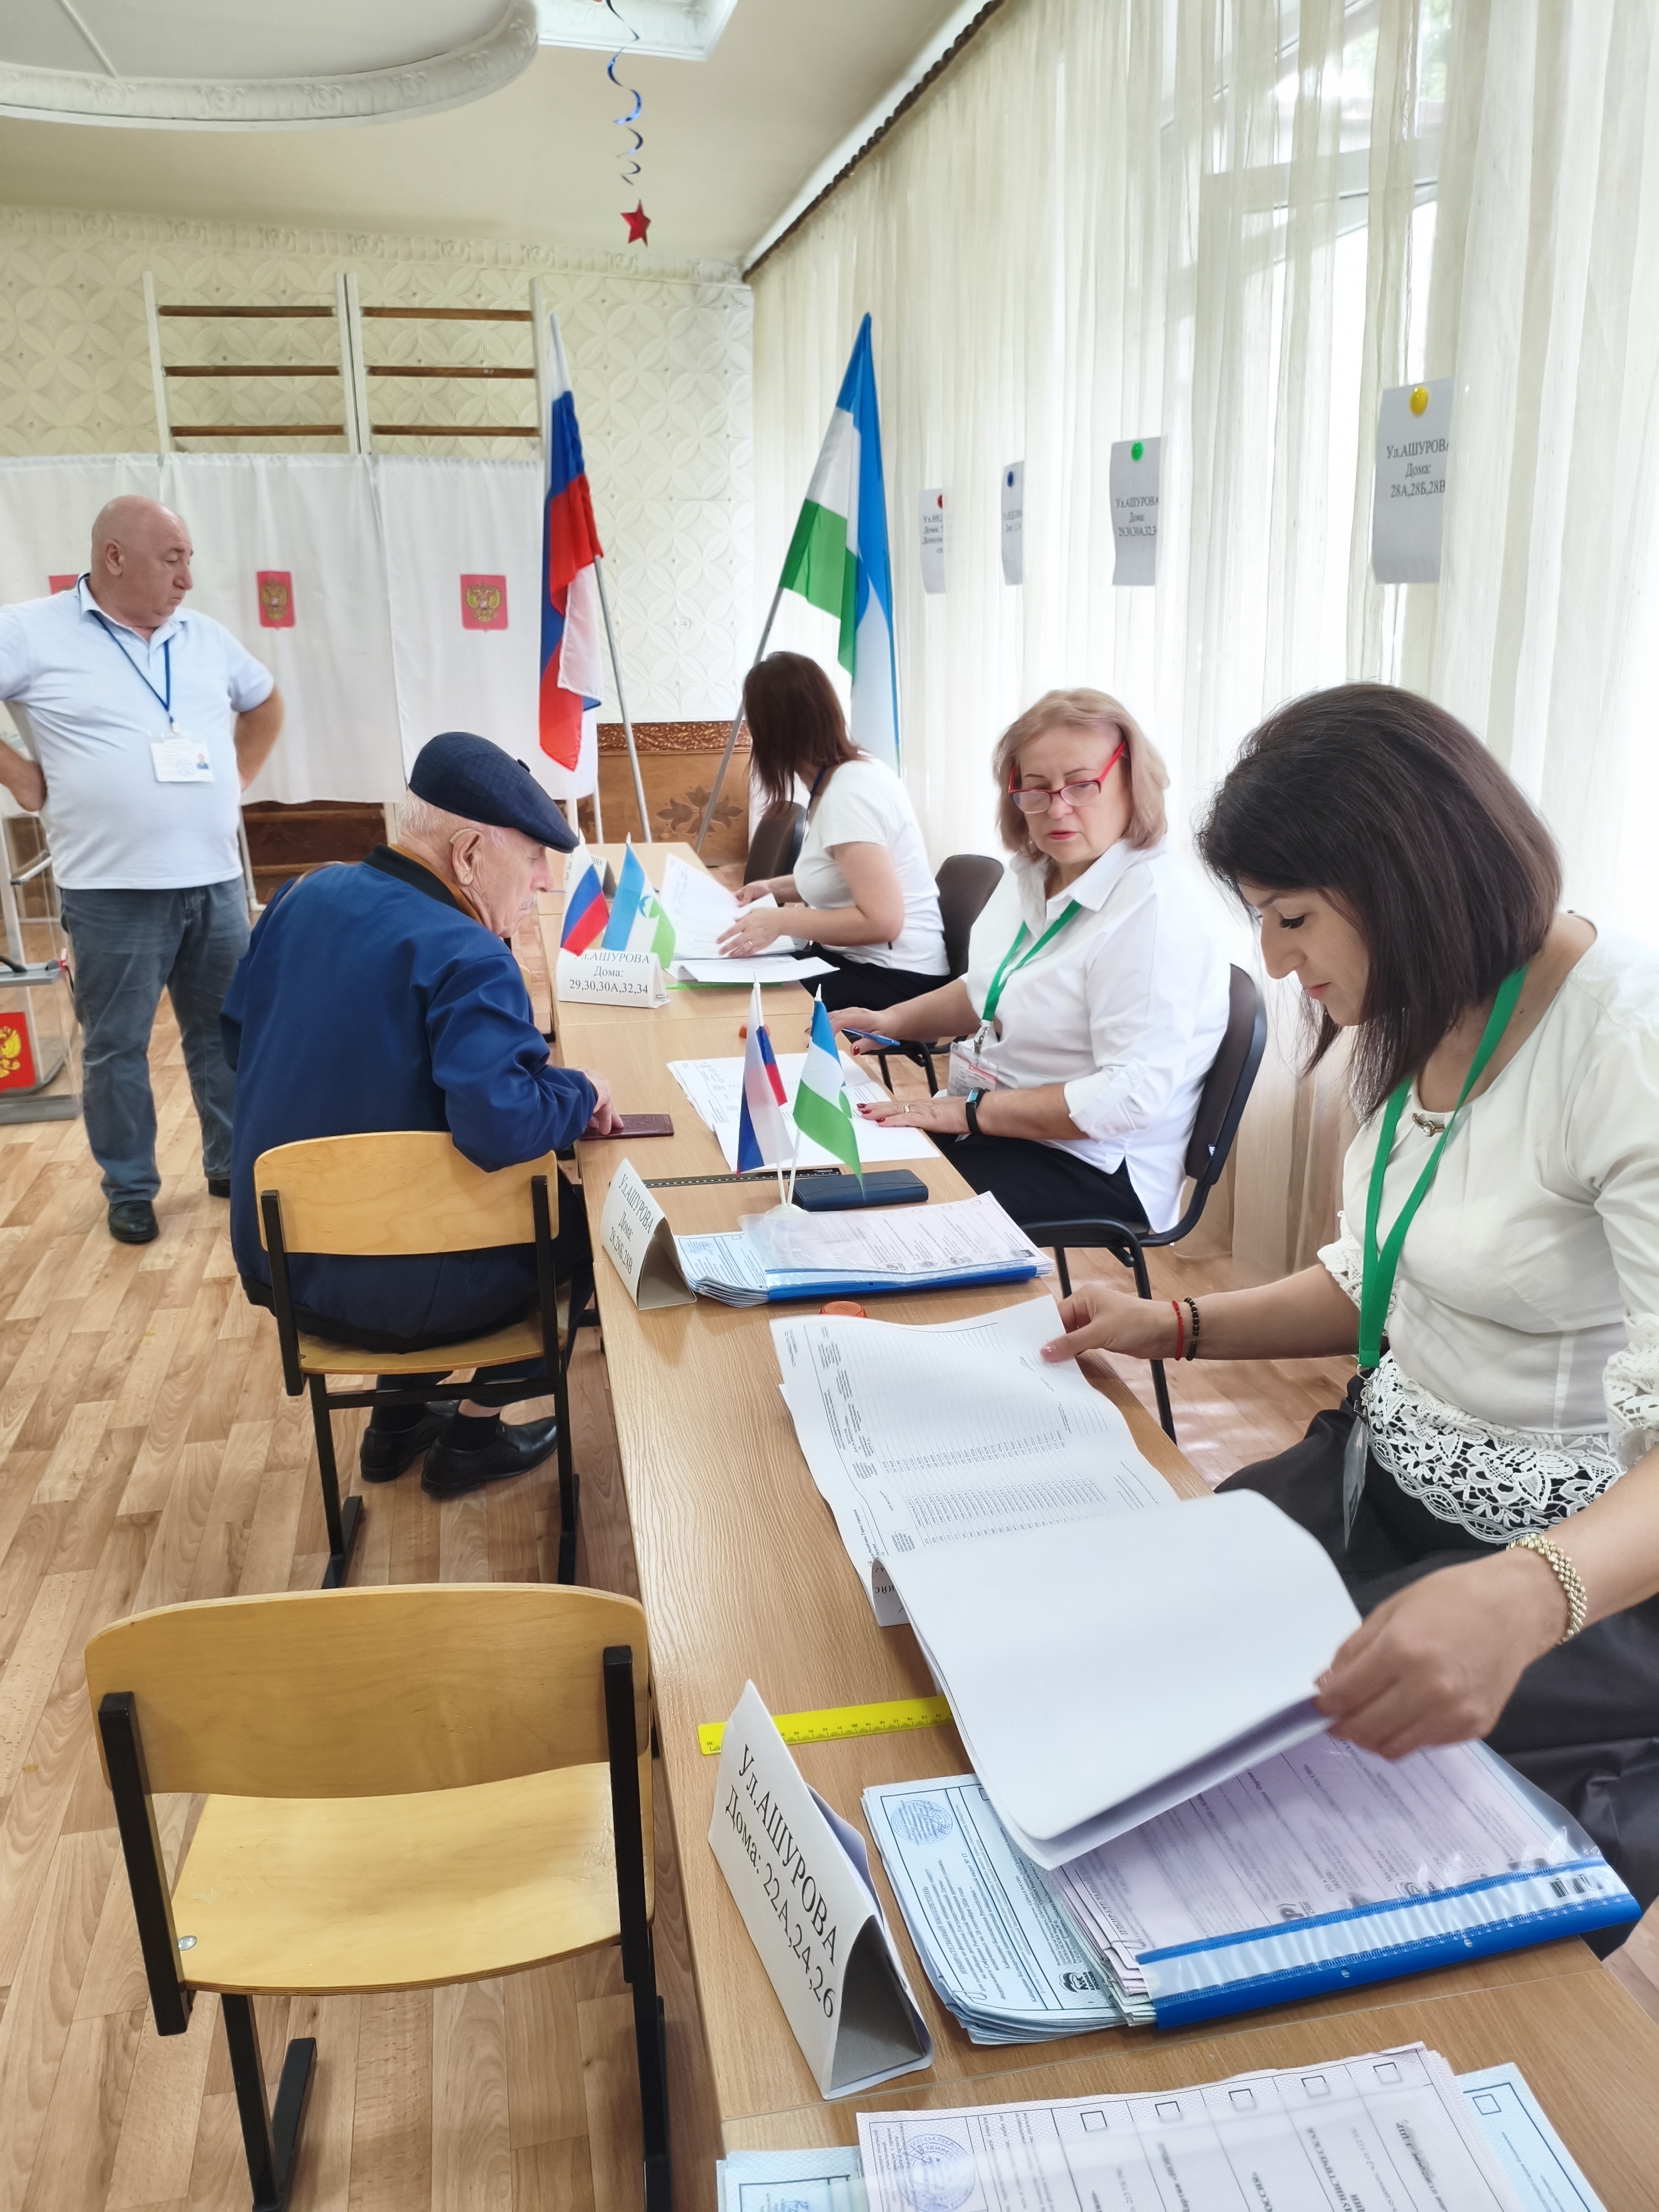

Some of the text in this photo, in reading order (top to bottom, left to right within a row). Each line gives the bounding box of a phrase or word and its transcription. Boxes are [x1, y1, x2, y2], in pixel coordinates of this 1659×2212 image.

[1405, 463, 1432, 478] Дома:
[569, 979, 648, 995] 29,30,30А,32,34
[594, 966, 623, 977] Дома:
[618, 1174, 654, 1234] Ул.АШУРОВА
[618, 1211, 633, 1242] Дома:
[610, 1226, 633, 1274] 28,28Б,28В
[739, 1743, 837, 1967] Ул.АШУРОВА
[725, 1784, 836, 2018] Дома: 22А,24,26
[1082, 1972, 1095, 1990] ЕДИНАЯ
[1088, 1971, 1101, 1988] РОССИЯ
[1250, 2172, 1273, 2212] ОССИЯ»
